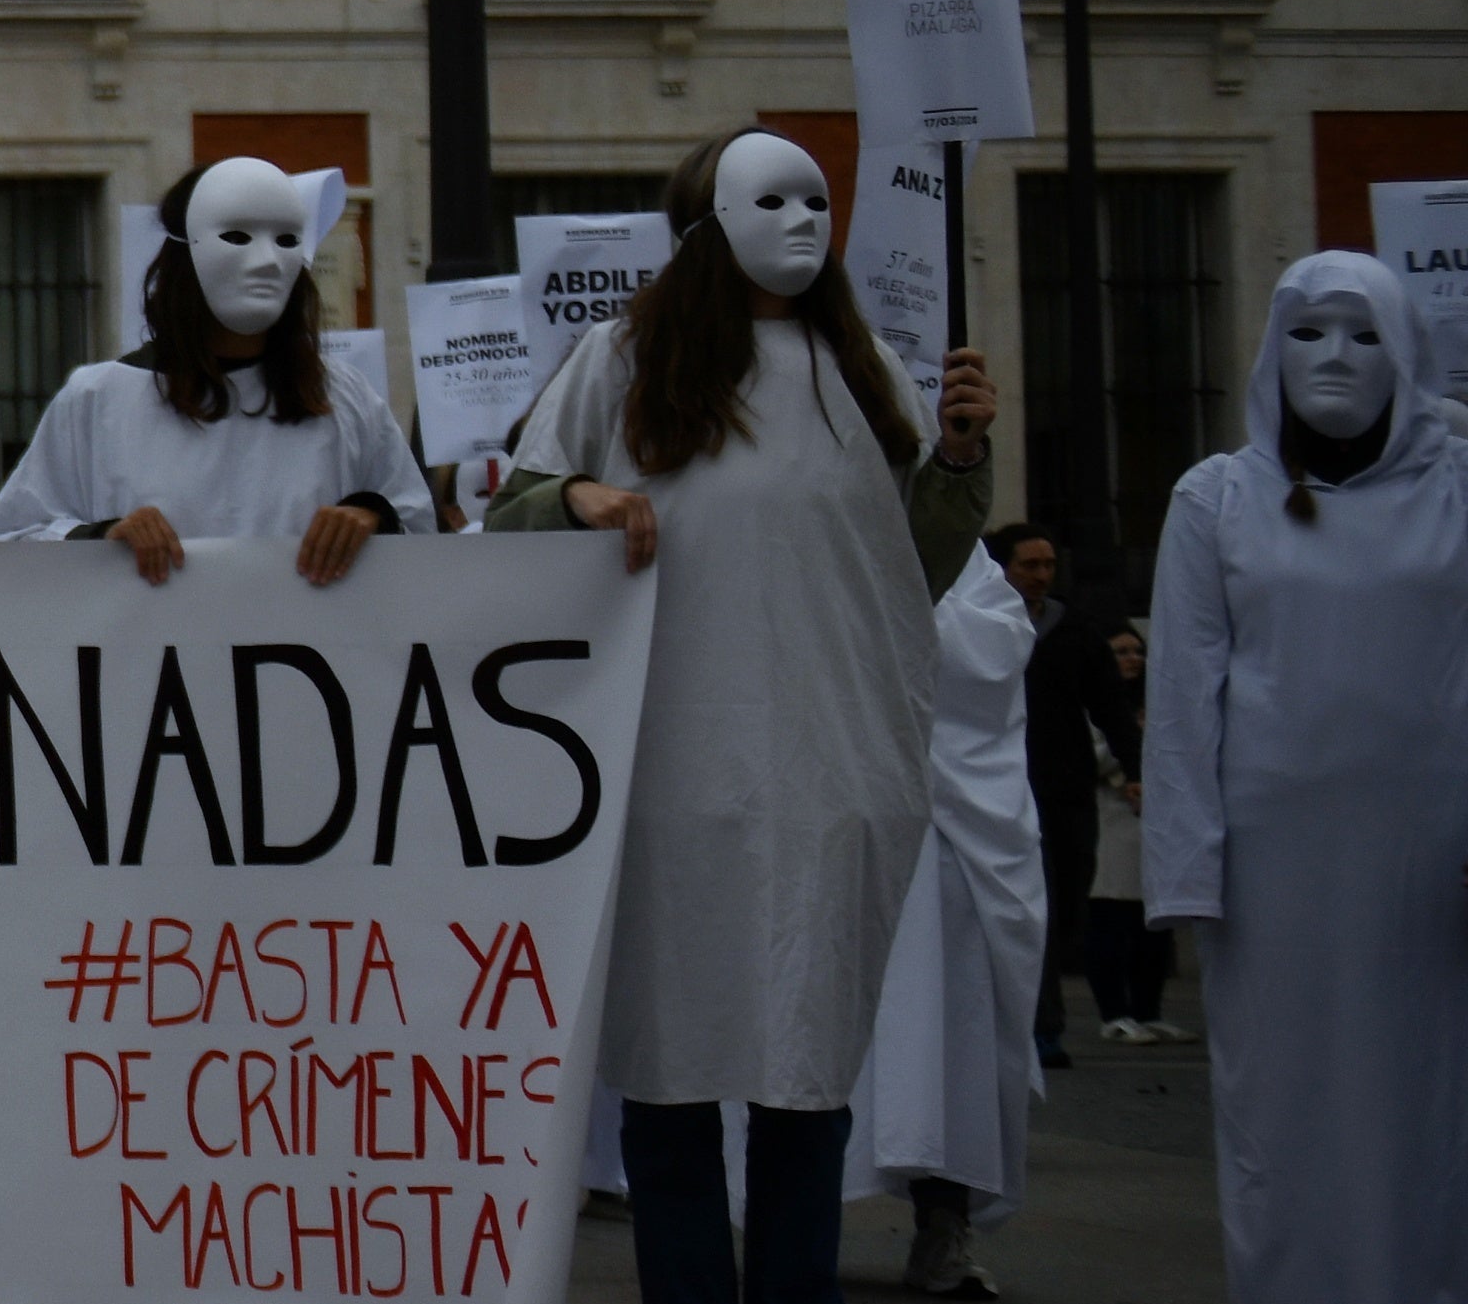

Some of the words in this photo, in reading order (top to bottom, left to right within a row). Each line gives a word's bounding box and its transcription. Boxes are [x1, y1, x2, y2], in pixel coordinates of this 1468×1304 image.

[909, 0, 976, 18] PIZARRA
[891, 165, 931, 198] ANA
[445, 330, 519, 351] NOMBRE
[43, 916, 408, 1030] #BASTA
[448, 920, 558, 1032] YA
[64, 1049, 169, 1161] DE
[119, 1170, 530, 1299] MACHISTA
